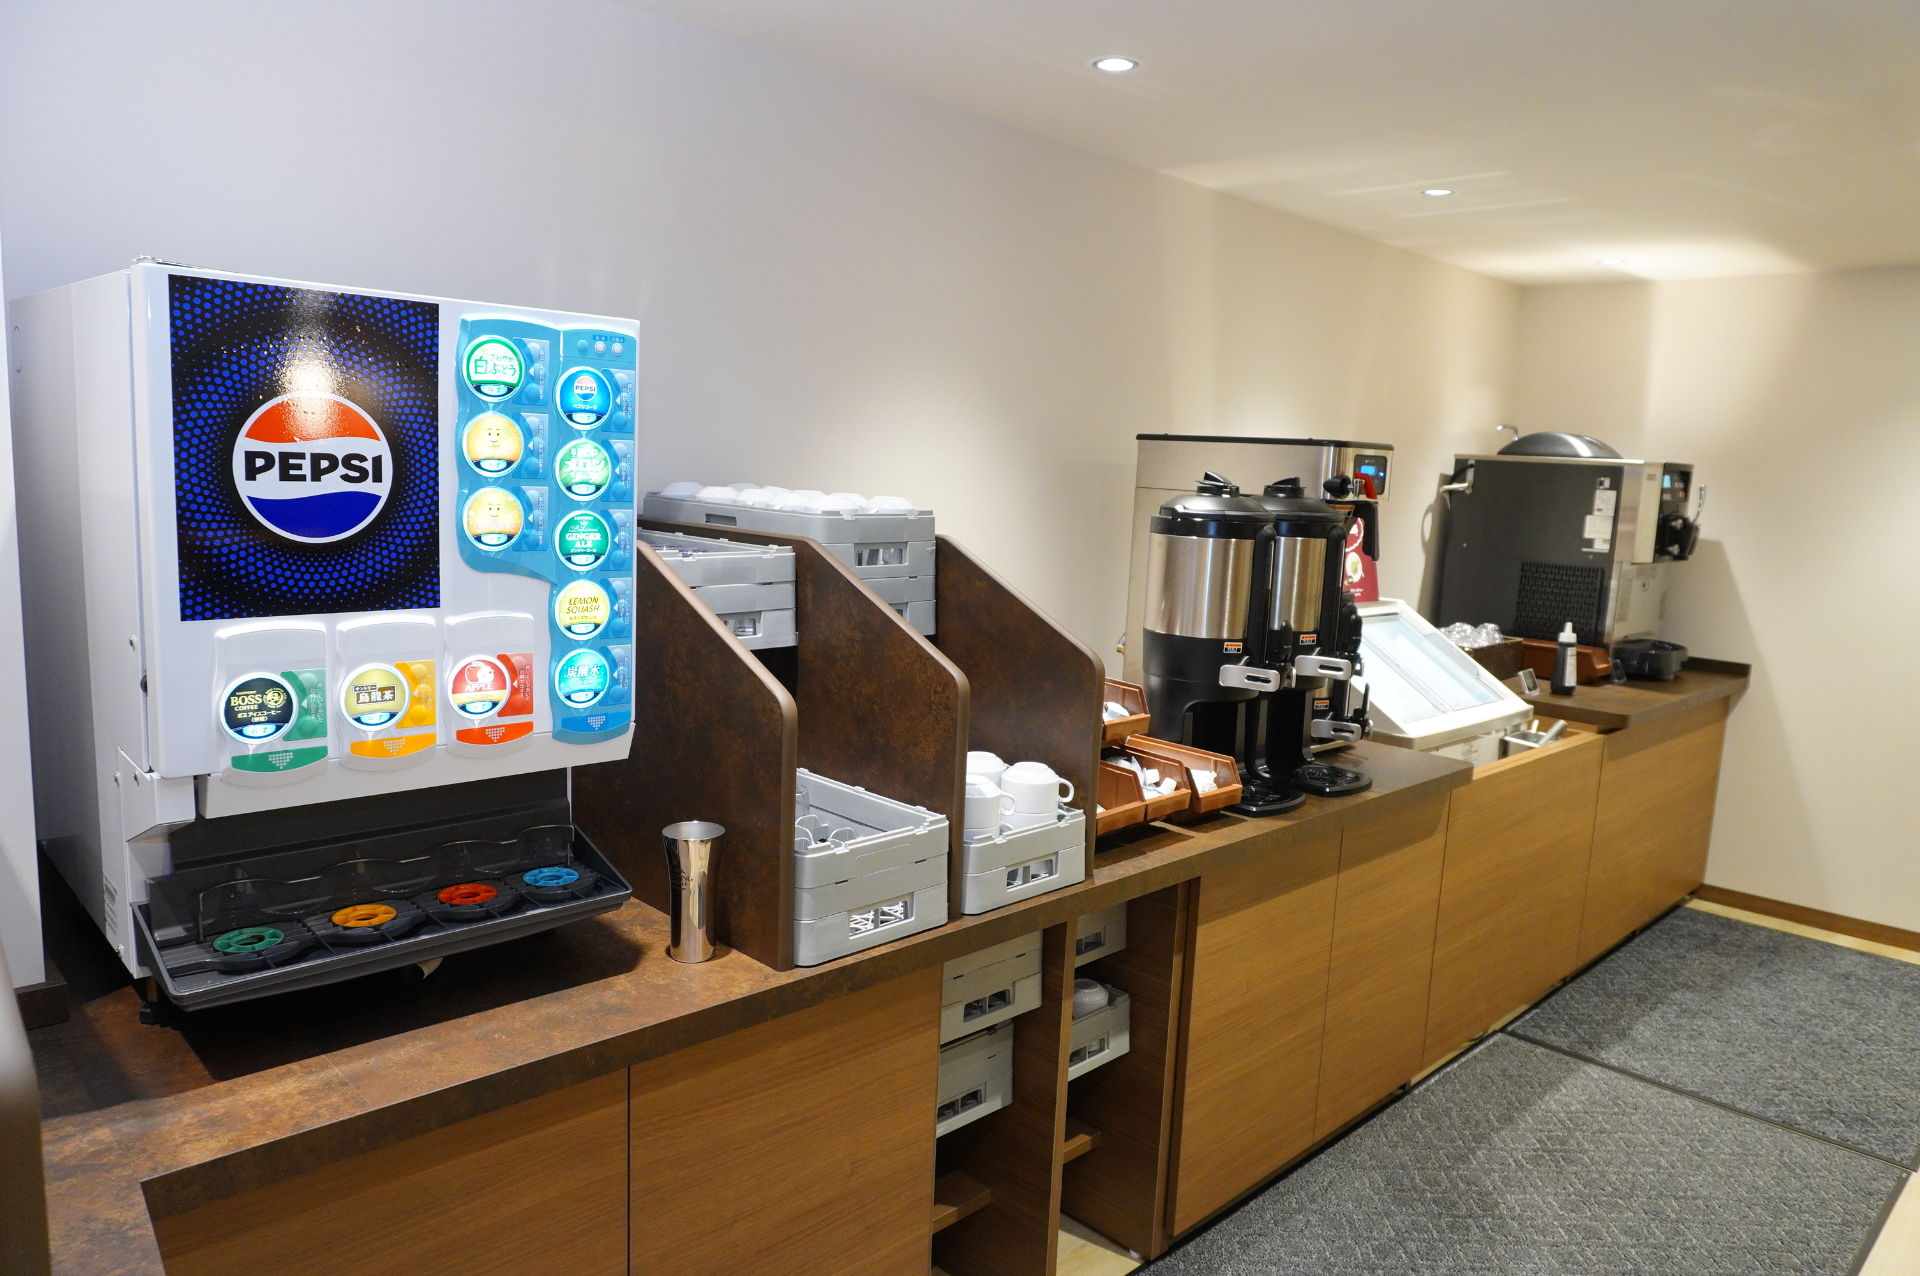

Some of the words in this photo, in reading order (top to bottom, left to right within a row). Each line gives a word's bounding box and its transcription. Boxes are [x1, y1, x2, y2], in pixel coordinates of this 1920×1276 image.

[474, 355, 517, 377] 白ぶどう
[244, 450, 383, 484] PEPSI
[563, 457, 605, 472] メロン
[570, 471, 598, 483] ソーダ
[565, 532, 602, 541] GINGER
[575, 540, 593, 548] ALE
[568, 596, 600, 606] LEMON
[566, 604, 600, 614] SQUASH
[565, 664, 601, 679] 炭酸水
[354, 684, 377, 692] サントリー
[465, 682, 494, 692] APPLE
[230, 694, 263, 706] BOSS
[358, 689, 395, 704] 烏龍茶
